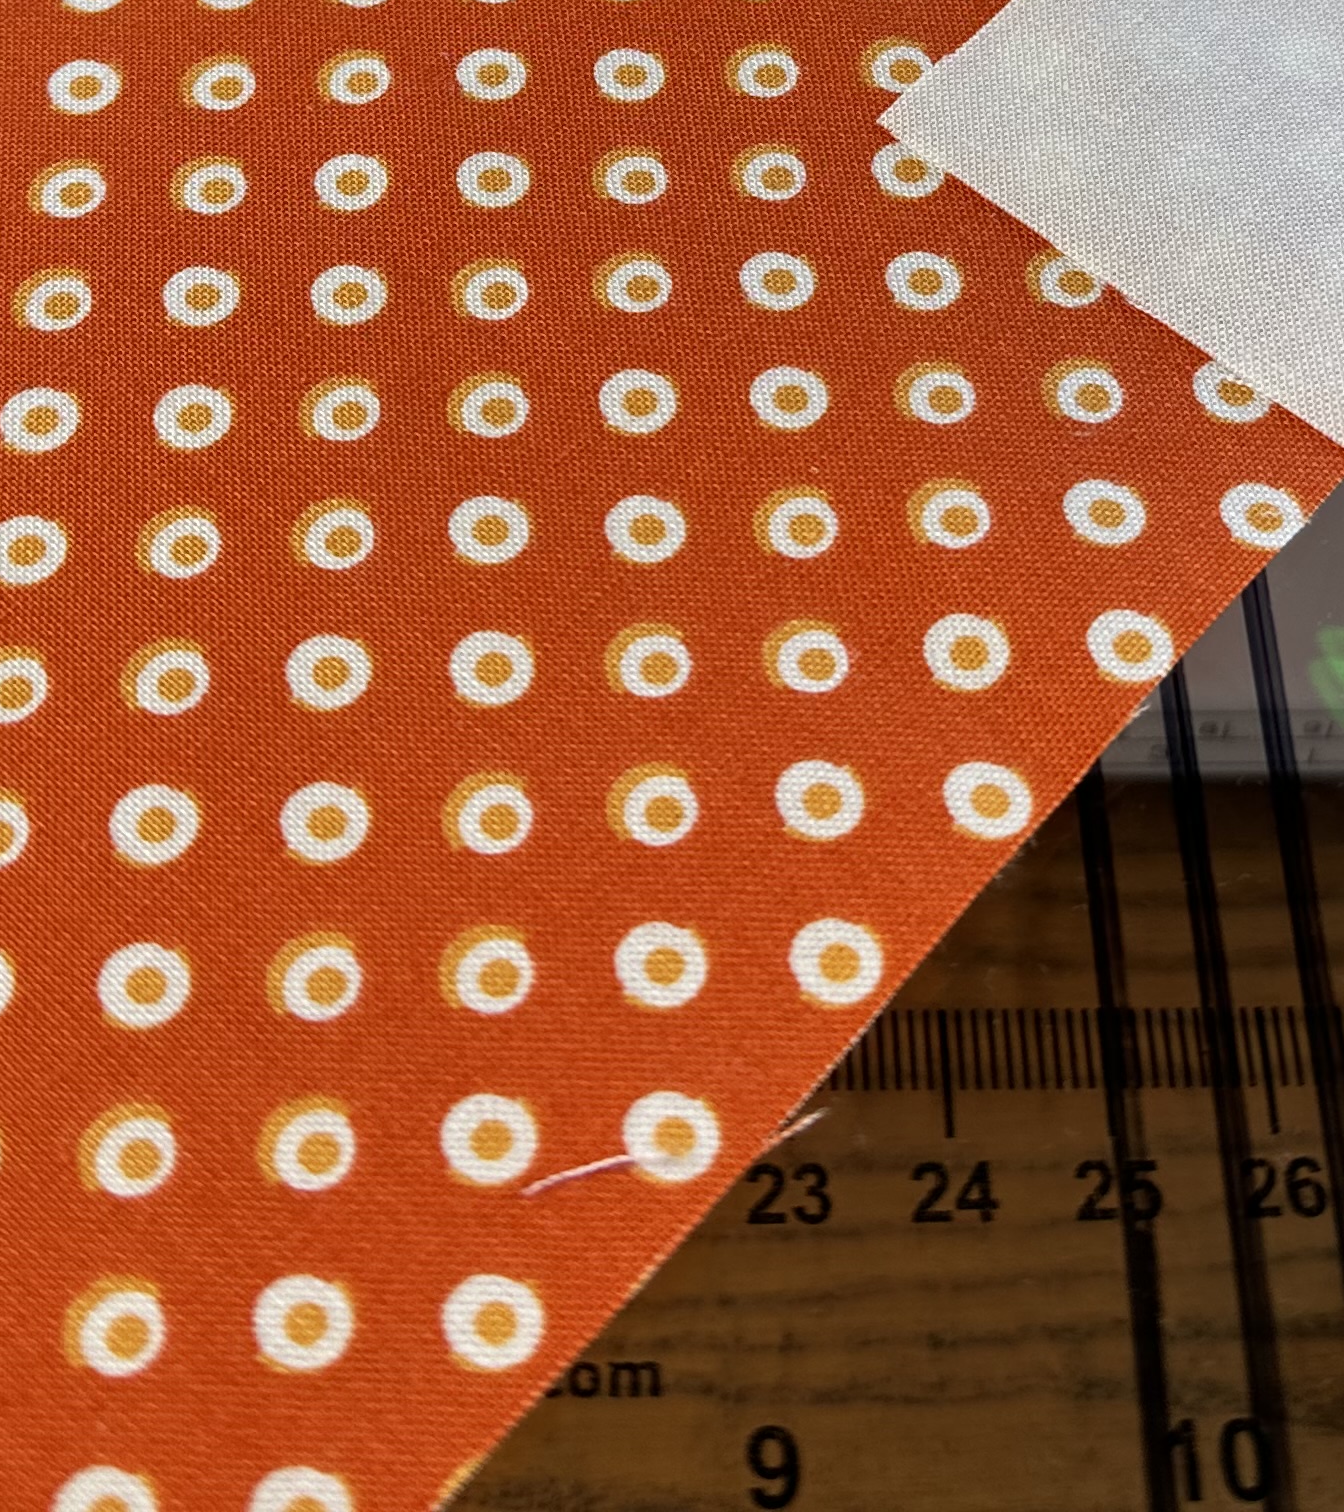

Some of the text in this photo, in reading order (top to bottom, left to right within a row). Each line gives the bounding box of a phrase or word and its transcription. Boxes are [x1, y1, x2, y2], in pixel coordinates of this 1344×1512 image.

[746, 1162, 832, 1225] 23
[911, 1160, 999, 1223] 24
[1073, 1159, 1163, 1222] 25
[1240, 1156, 1328, 1218] 26
[545, 1360, 662, 1399] om
[746, 1424, 800, 1510] 9
[1164, 1417, 1273, 1502] 10
